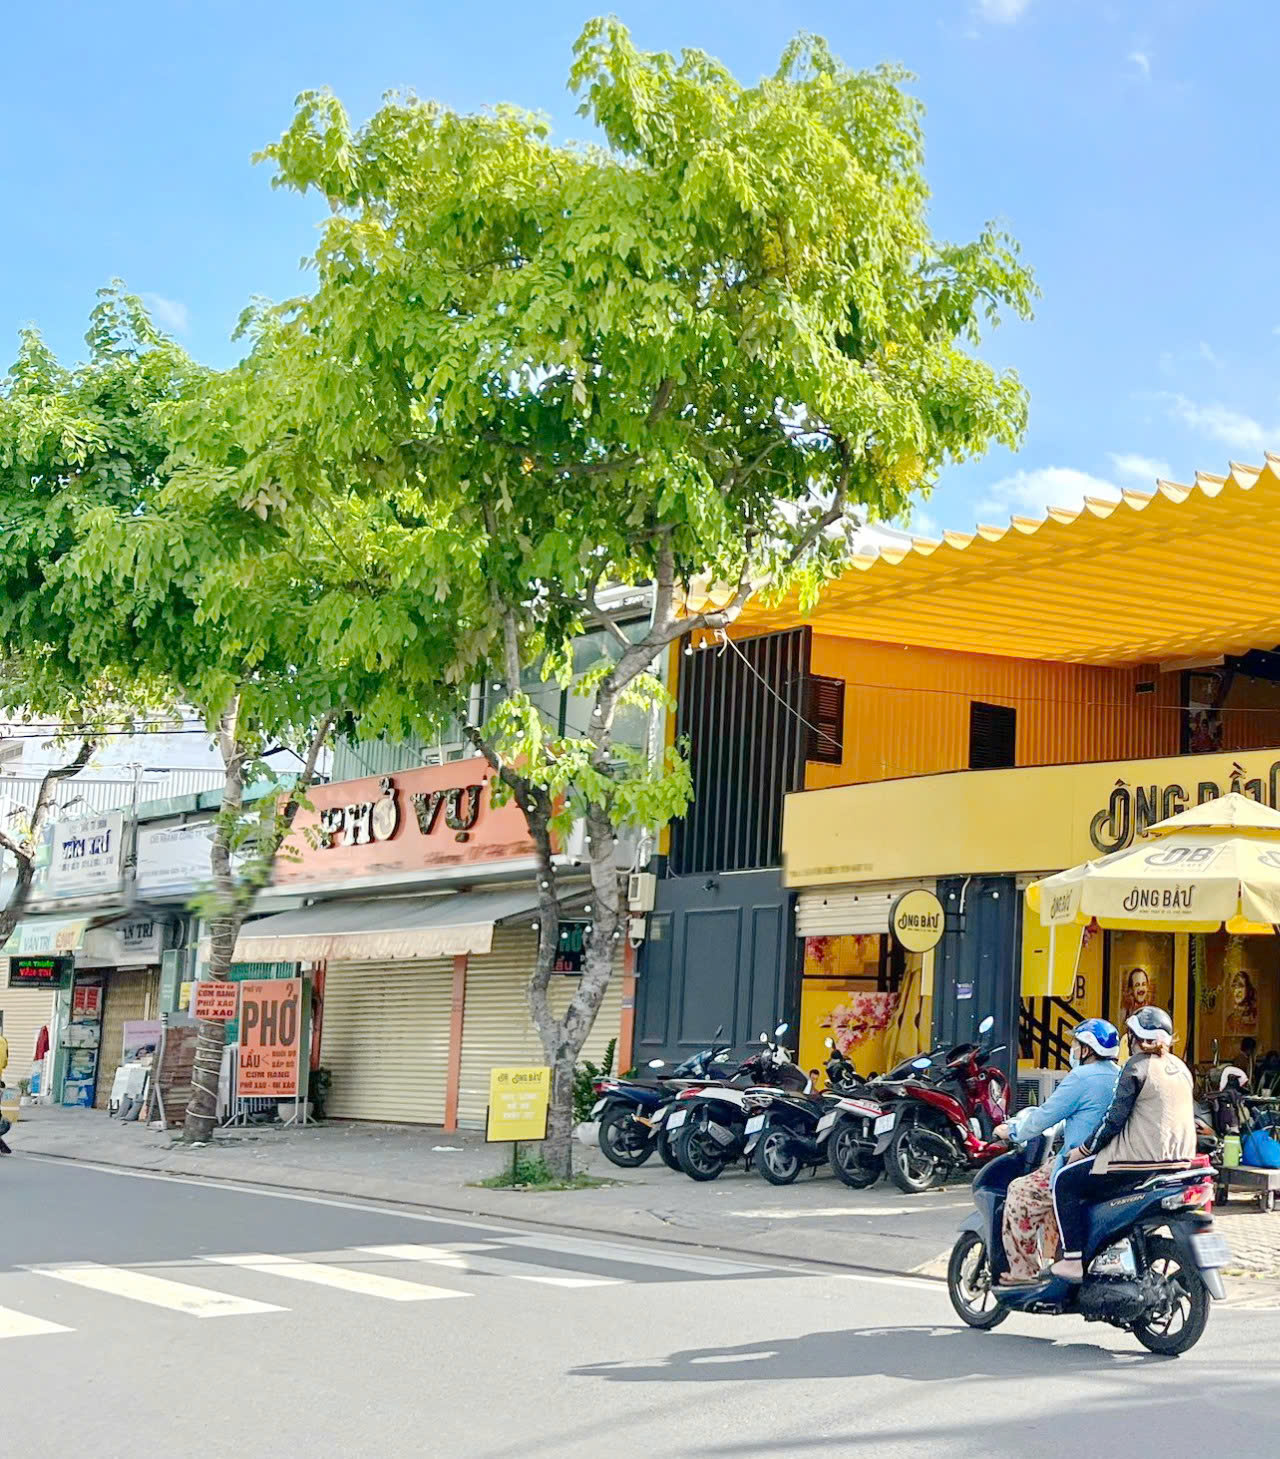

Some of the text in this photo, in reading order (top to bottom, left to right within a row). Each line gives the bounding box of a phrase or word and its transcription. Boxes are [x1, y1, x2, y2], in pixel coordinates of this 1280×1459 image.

[318, 776, 484, 850] PHỞ VỤ
[1089, 778, 1188, 855] ÔNG
[897, 911, 940, 930] ÔNG BẦU
[1123, 883, 1197, 912] ÔNG BẦU
[241, 982, 299, 1047] PHỞ
